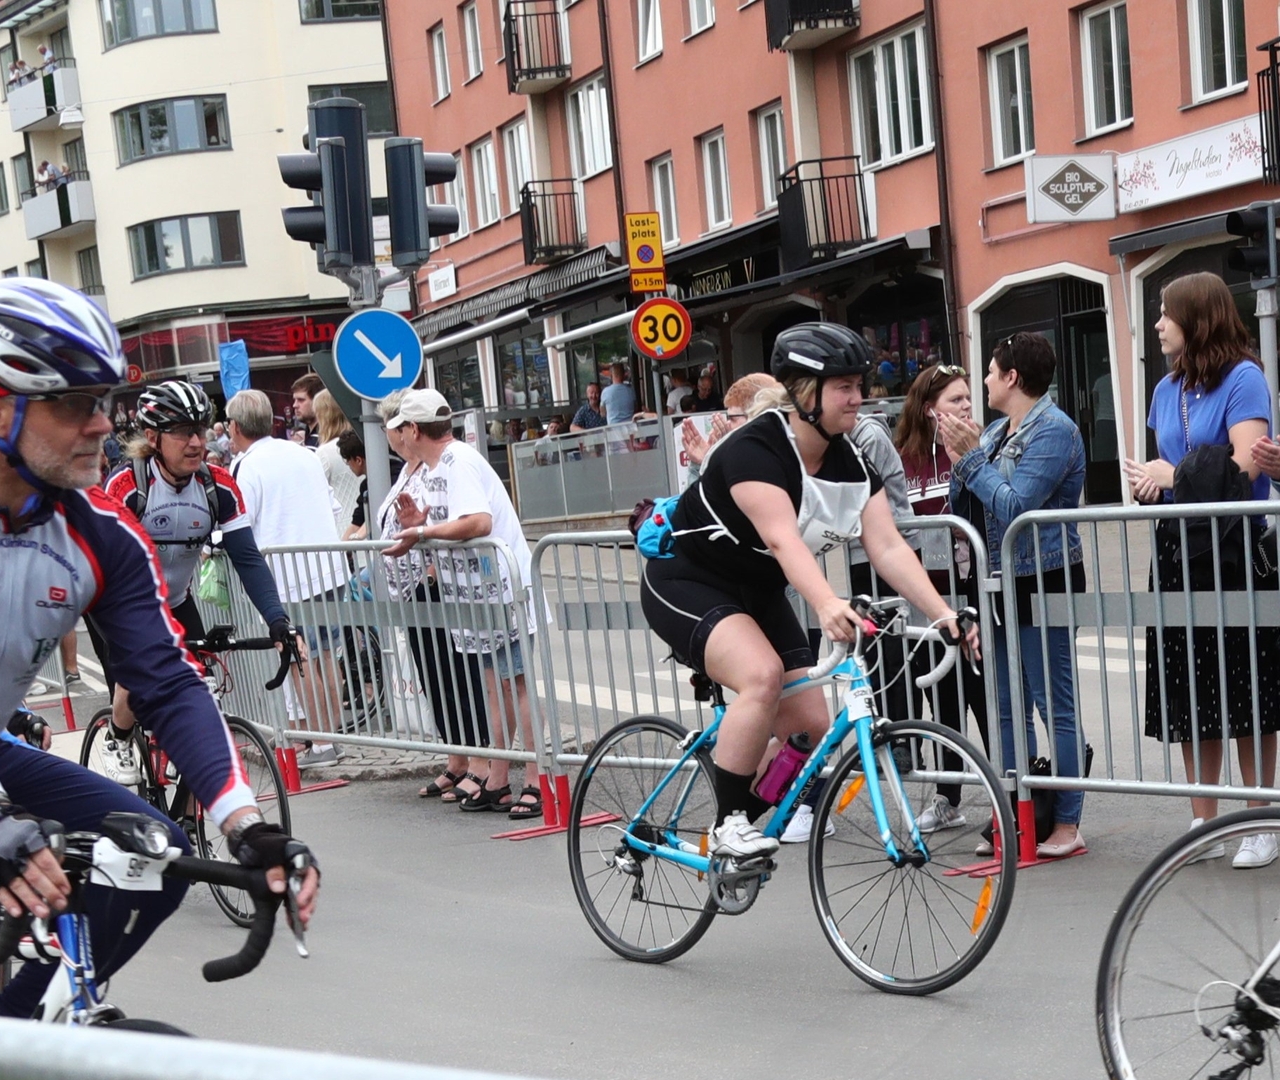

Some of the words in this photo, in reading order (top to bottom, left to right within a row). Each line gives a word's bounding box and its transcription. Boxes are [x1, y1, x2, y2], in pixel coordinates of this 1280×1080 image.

[1065, 172, 1080, 182] BIO
[1049, 183, 1098, 193] SCULPTURE
[1064, 194, 1083, 204] GEL
[630, 218, 656, 227] Last-
[631, 230, 656, 240] plats
[633, 277, 663, 287] 0-15m
[642, 313, 683, 344] 30
